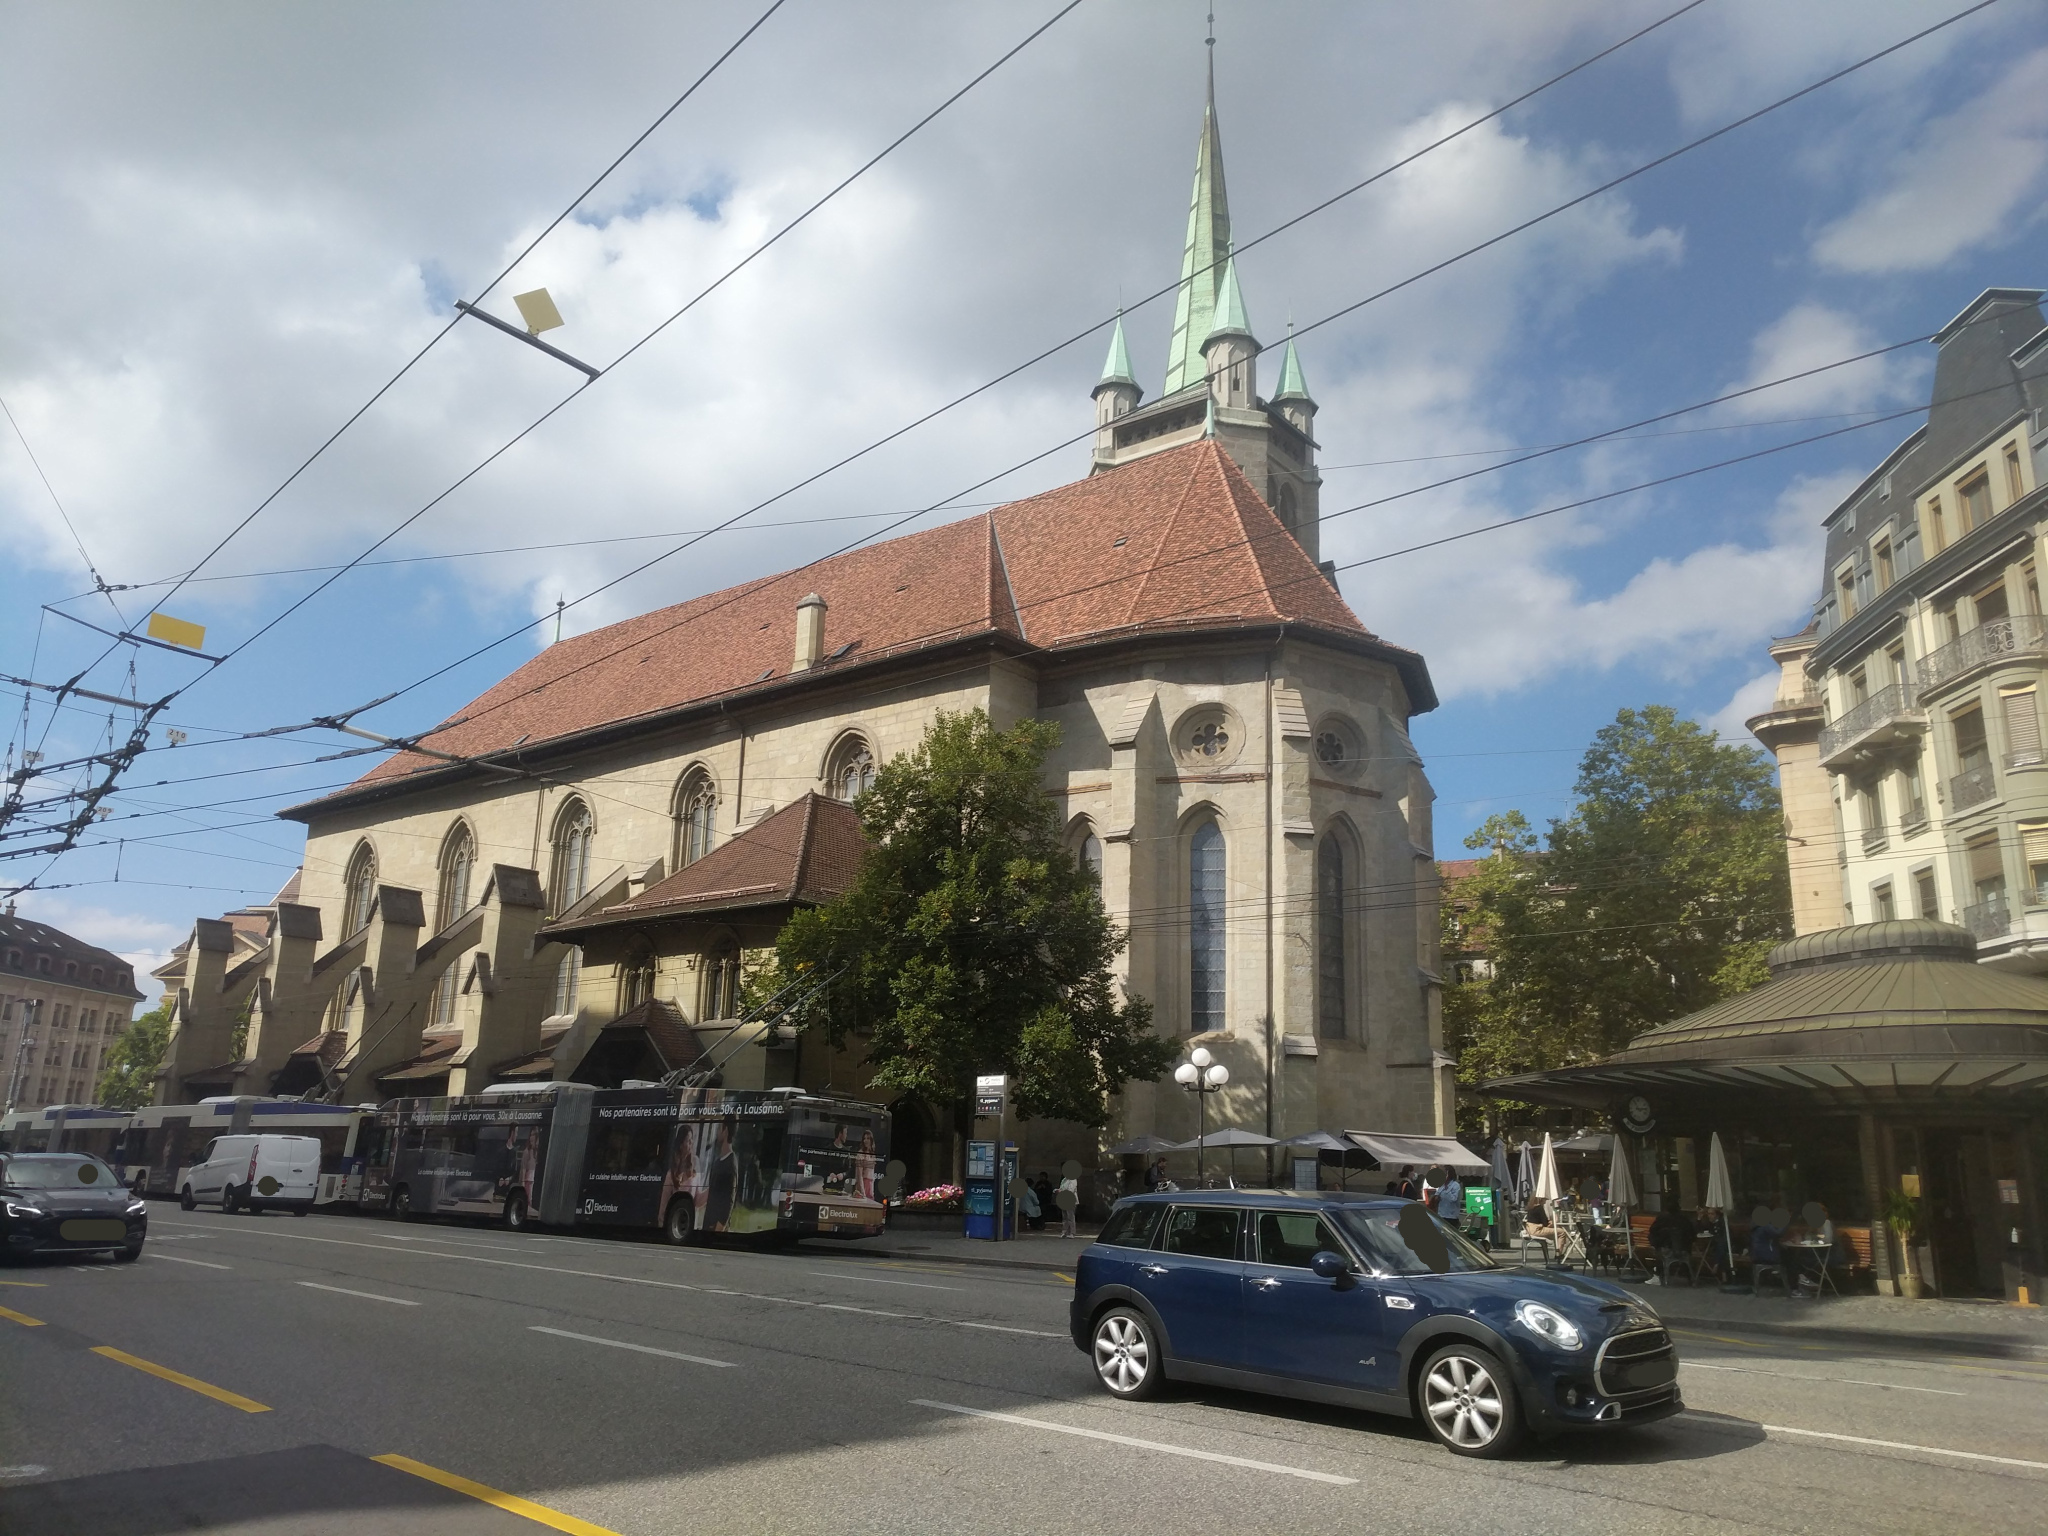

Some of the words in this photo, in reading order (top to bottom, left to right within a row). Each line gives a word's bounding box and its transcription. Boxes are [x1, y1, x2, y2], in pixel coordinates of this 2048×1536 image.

[168, 729, 186, 739] 210
[26, 750, 40, 758] 210
[599, 1107, 612, 1118] Nos
[613, 1107, 652, 1119] partenaires
[653, 1106, 669, 1117] sont
[670, 1105, 677, 1116] là
[678, 1106, 696, 1118] pour
[698, 1106, 718, 1117] vous,
[719, 1104, 734, 1116] 30x
[736, 1104, 742, 1115] à
[744, 1103, 785, 1115] Lausanne.
[411, 1113, 420, 1122] Nos
[421, 1113, 449, 1123] partenaires
[450, 1113, 462, 1122] sont
[462, 1112, 468, 1121] là
[468, 1113, 482, 1123] pour
[483, 1113, 496, 1122] vous,
[497, 1111, 508, 1121] 30x
[508, 1112, 514, 1121] à
[514, 1111, 543, 1121] Lausanne.
[589, 1172, 596, 1180] La
[596, 1172, 610, 1181] cuisine
[610, 1173, 628, 1181] intuitive
[628, 1174, 639, 1182] avec
[639, 1173, 662, 1182] Electrolux
[594, 1202, 619, 1213] Electrolux
[829, 1209, 858, 1219] Electrolux
